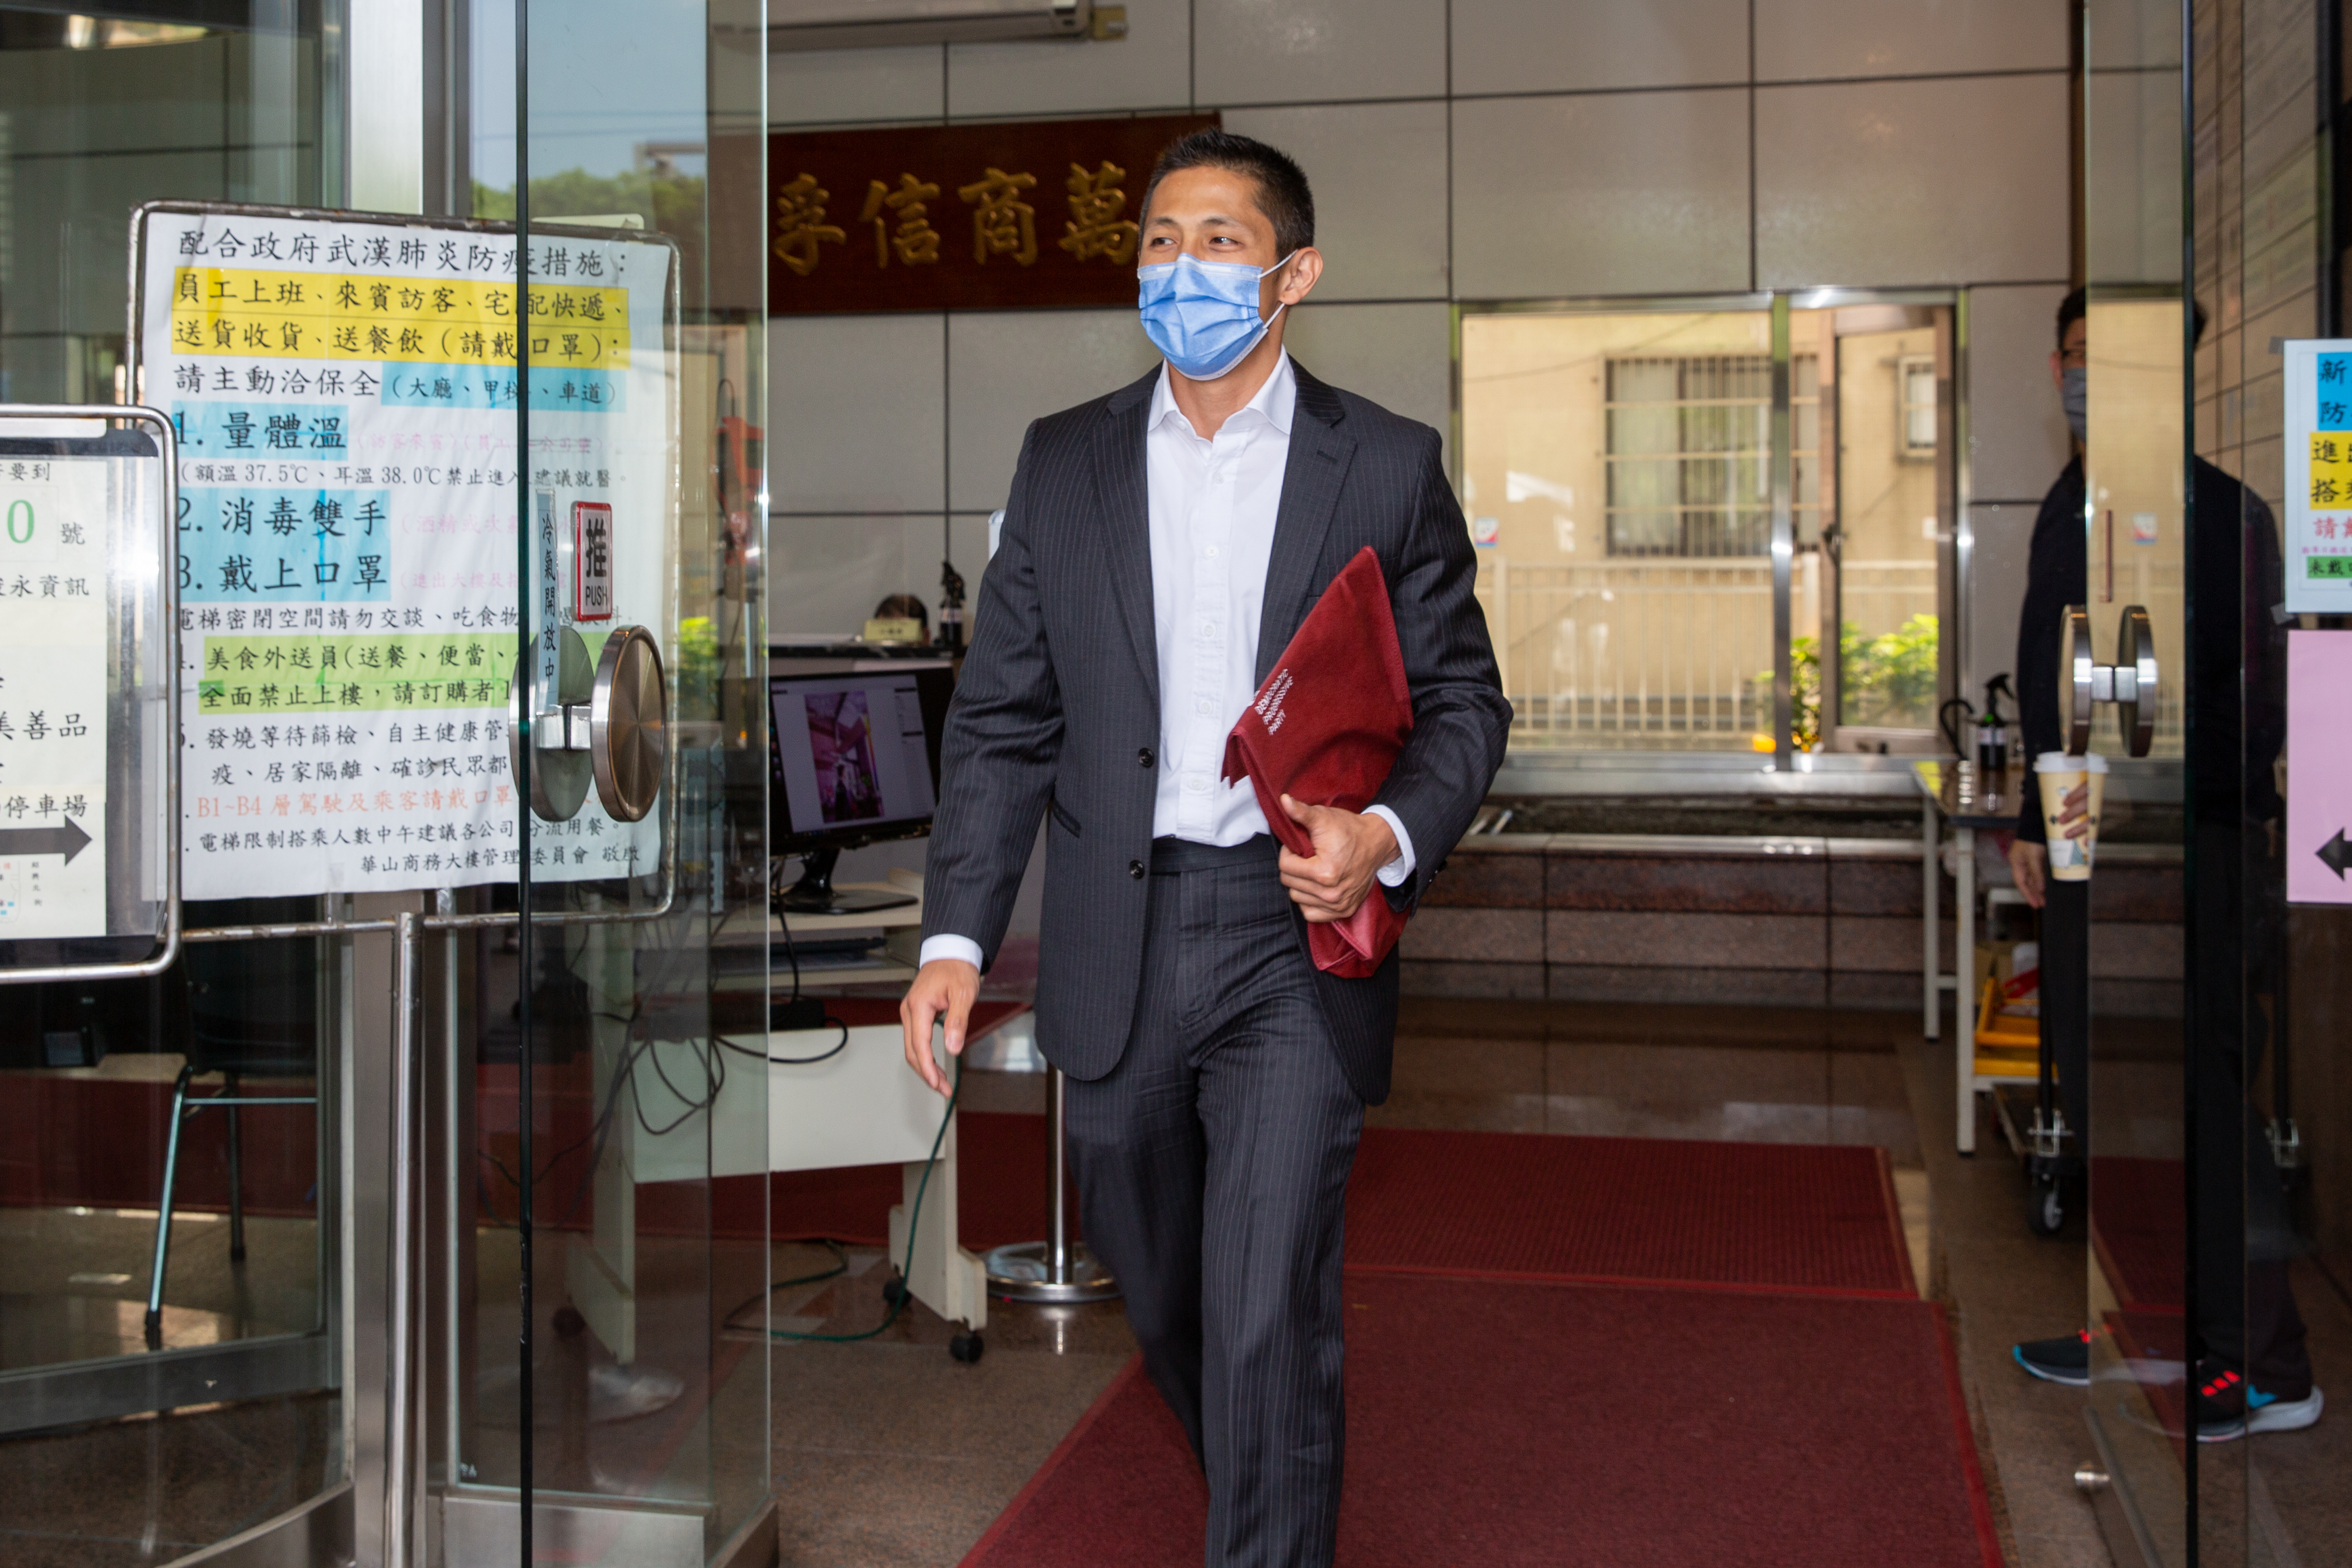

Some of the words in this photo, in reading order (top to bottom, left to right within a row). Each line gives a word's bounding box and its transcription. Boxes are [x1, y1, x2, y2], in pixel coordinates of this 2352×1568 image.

[2312, 440, 2352, 463] 進
[0, 462, 50, 481] 要到
[2311, 479, 2352, 503] 搭
[585, 518, 607, 578] 推
[0, 574, 90, 598] 永資訊
[585, 585, 608, 606] PUSH
[541, 513, 556, 687] 冷氣開放中
[1255, 669, 1288, 715] DEMOCRATIC
[1268, 709, 1286, 736] PARTY
[4, 794, 88, 819] 停車場
